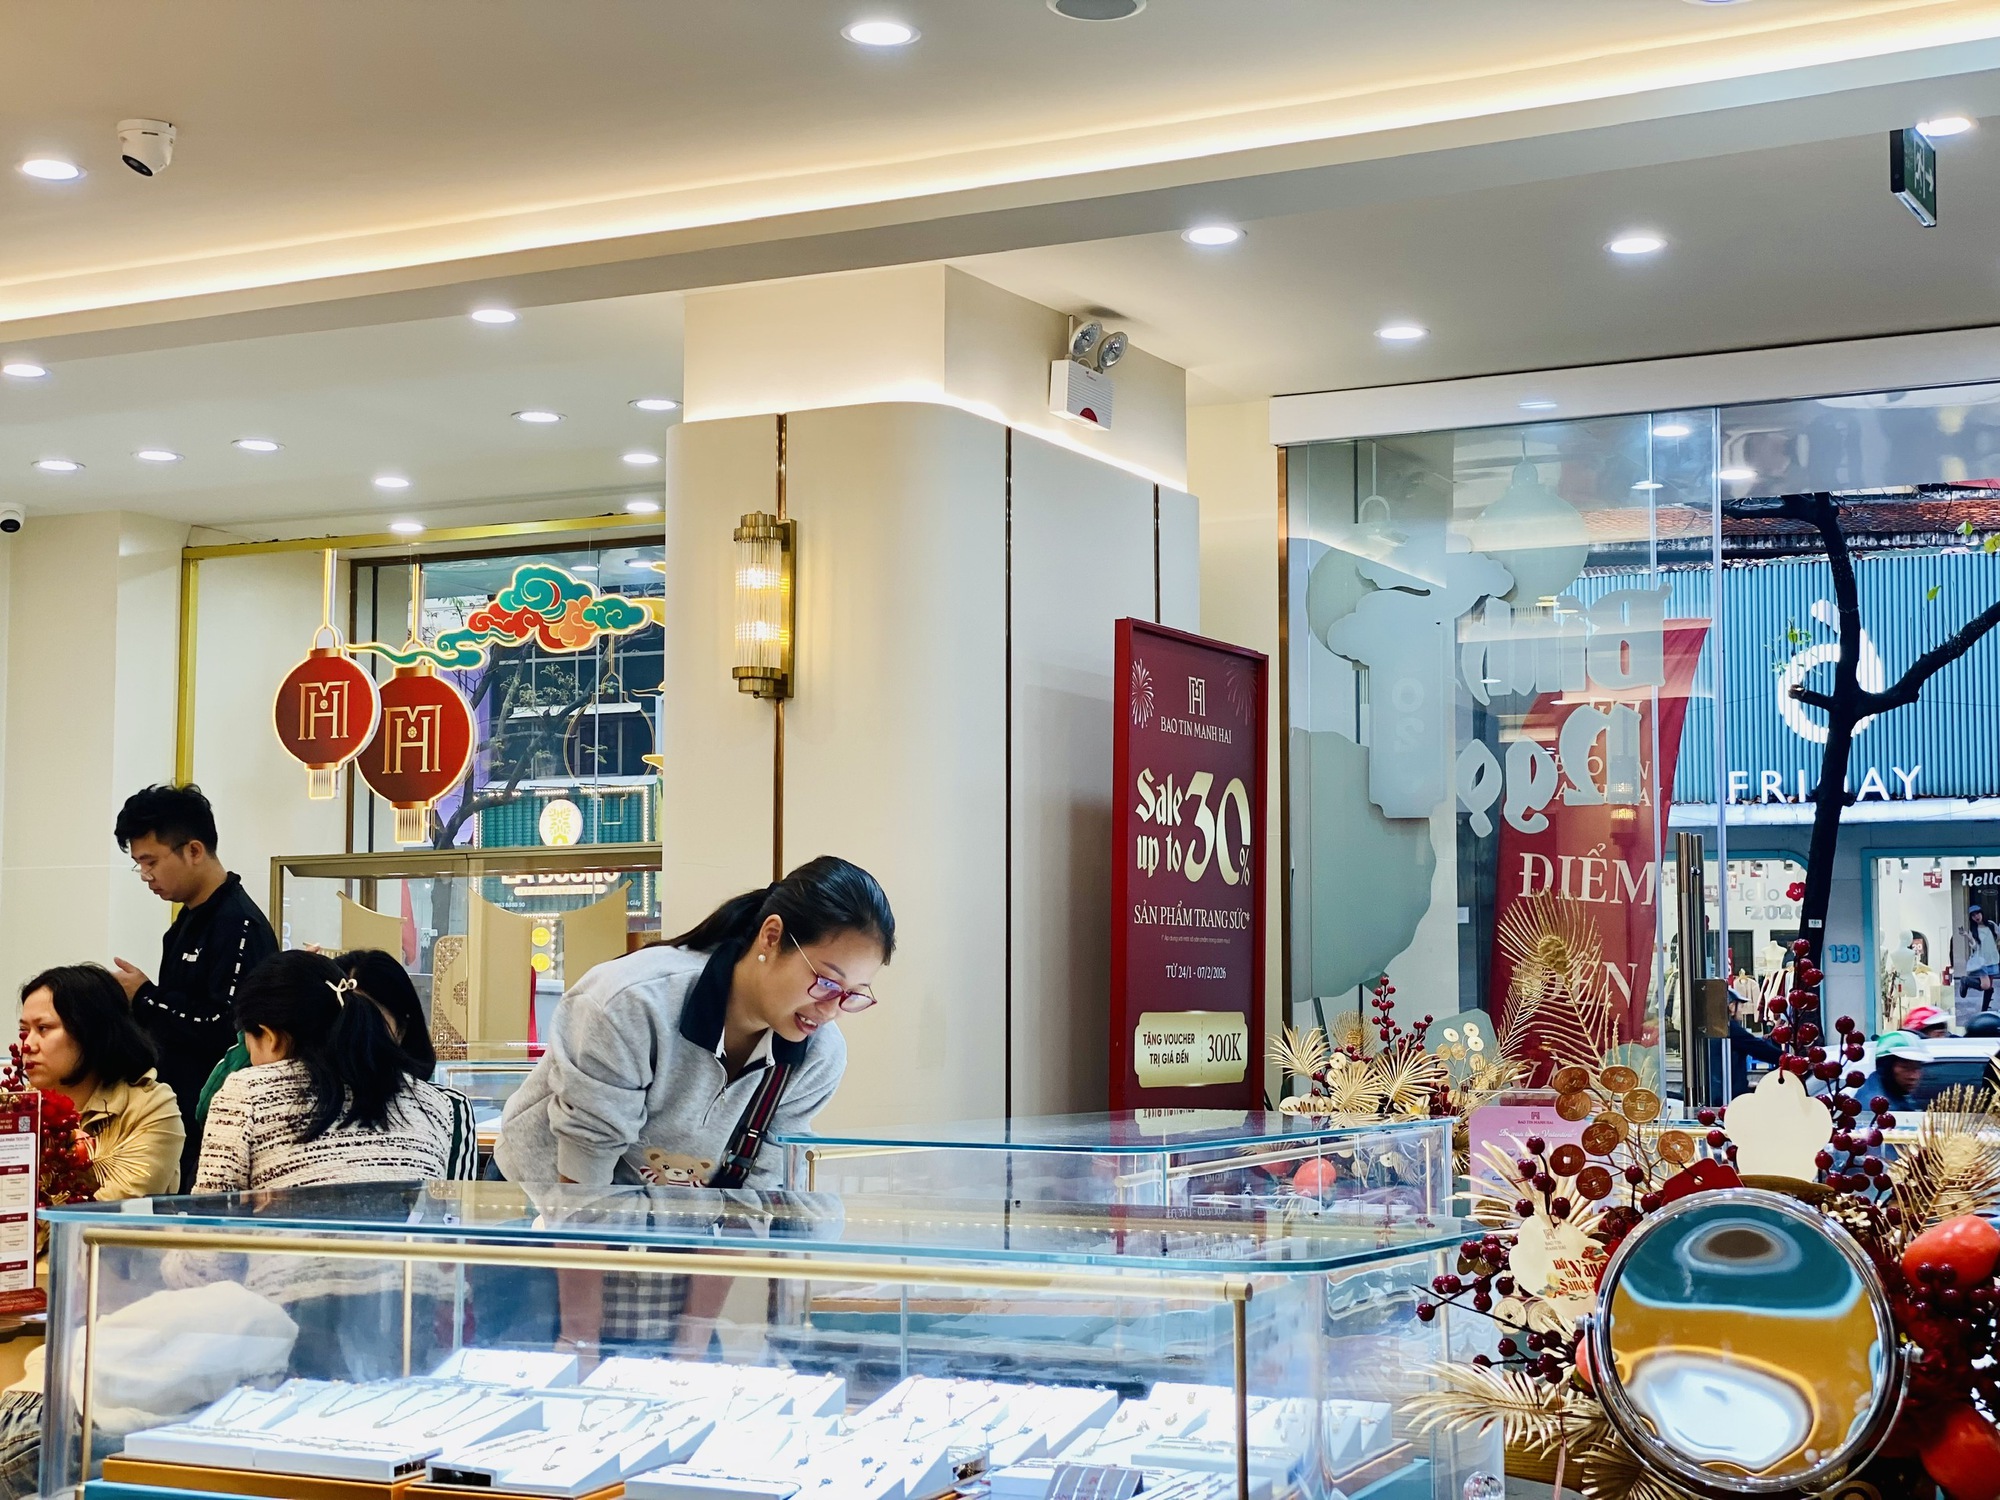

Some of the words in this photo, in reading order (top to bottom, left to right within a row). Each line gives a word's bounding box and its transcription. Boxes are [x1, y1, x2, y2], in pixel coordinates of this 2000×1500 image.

[1160, 715, 1178, 734] BAO
[1178, 719, 1193, 737] TIN
[1194, 722, 1218, 742] MANH
[1218, 728, 1232, 744] HAI
[1135, 767, 1183, 827] Sale
[1728, 765, 1922, 805] FRIAY
[1136, 834, 1160, 879] up
[1165, 830, 1182, 873] to
[1517, 842, 1656, 906] ĐIỂM
[1134, 899, 1158, 924] SẢN
[1160, 900, 1193, 927] PHẨM
[1194, 908, 1228, 929] TRANG
[1828, 944, 1861, 964] 138
[1142, 1031, 1162, 1049] TẶNG
[1163, 1032, 1196, 1046] VOUCHER
[1206, 1032, 1243, 1063] 300K
[1149, 1053, 1160, 1067] TRỊ
[1162, 1050, 1174, 1064] GIÁ
[1175, 1048, 1189, 1064] ĐẾN
